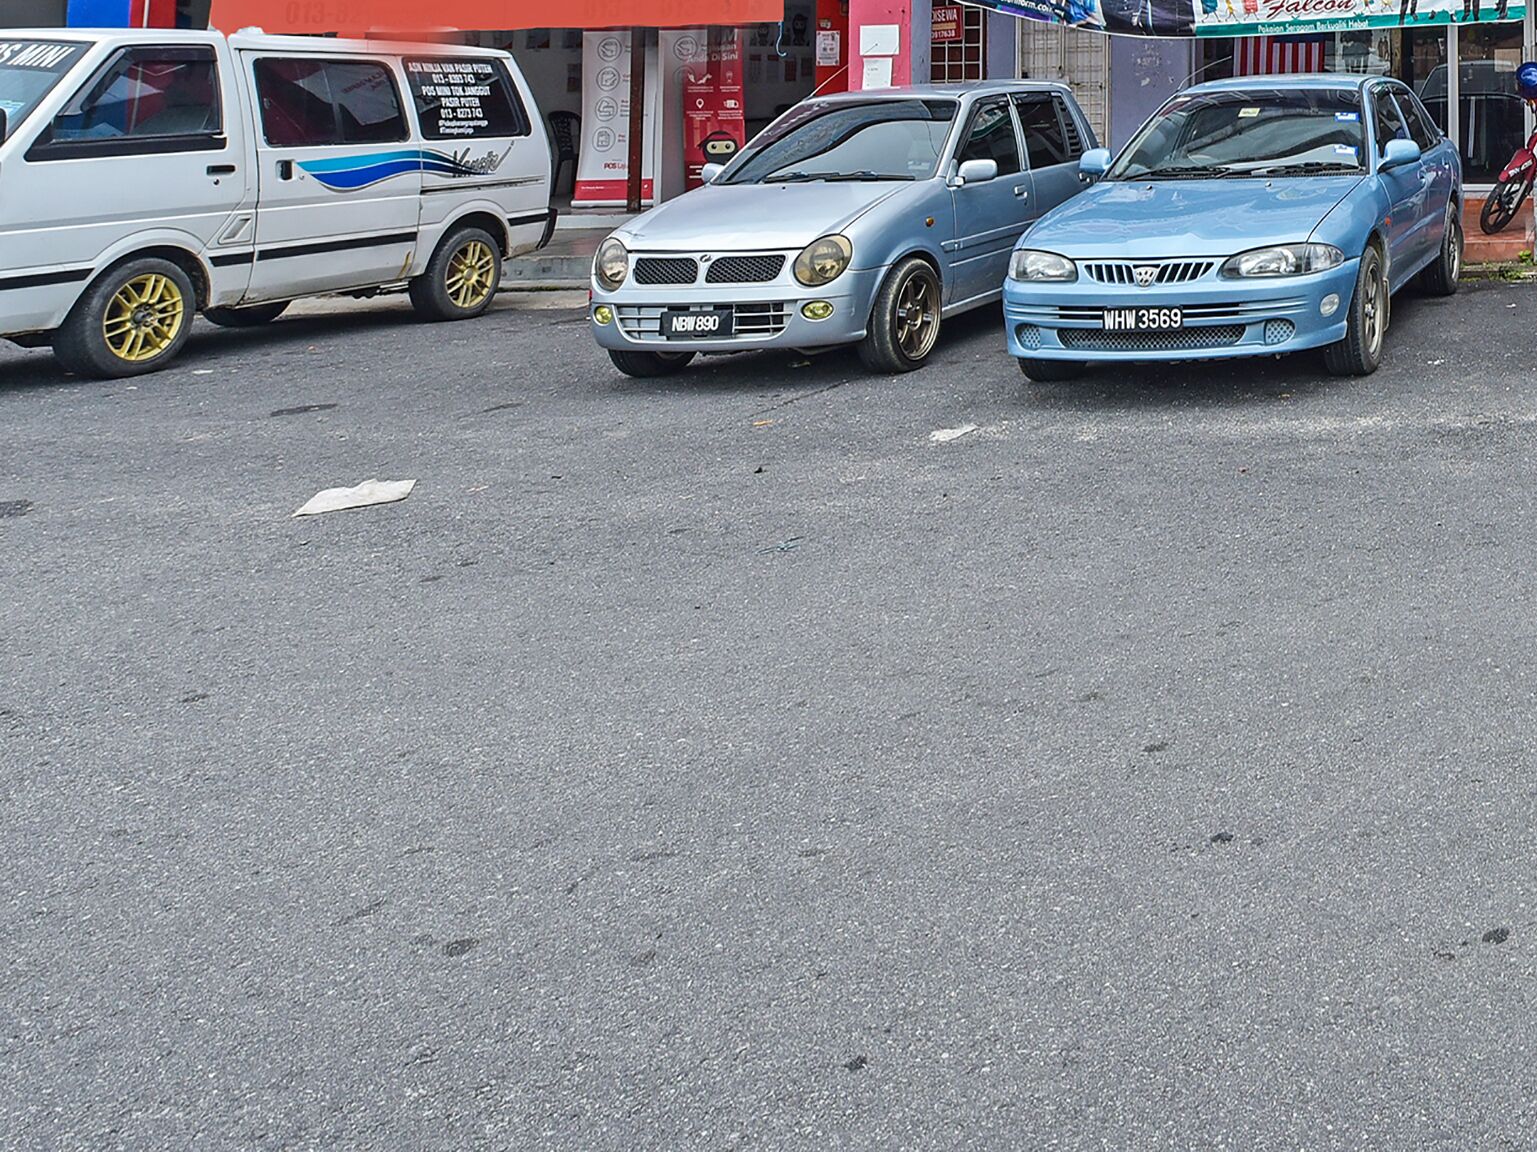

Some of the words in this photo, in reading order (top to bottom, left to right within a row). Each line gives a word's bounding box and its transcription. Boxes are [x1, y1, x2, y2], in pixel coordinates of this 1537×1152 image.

[7, 44, 77, 68] MINI
[671, 315, 696, 332] NBW
[695, 314, 719, 332] 890
[1103, 309, 1136, 330] WHW
[1138, 308, 1181, 329] 3569
